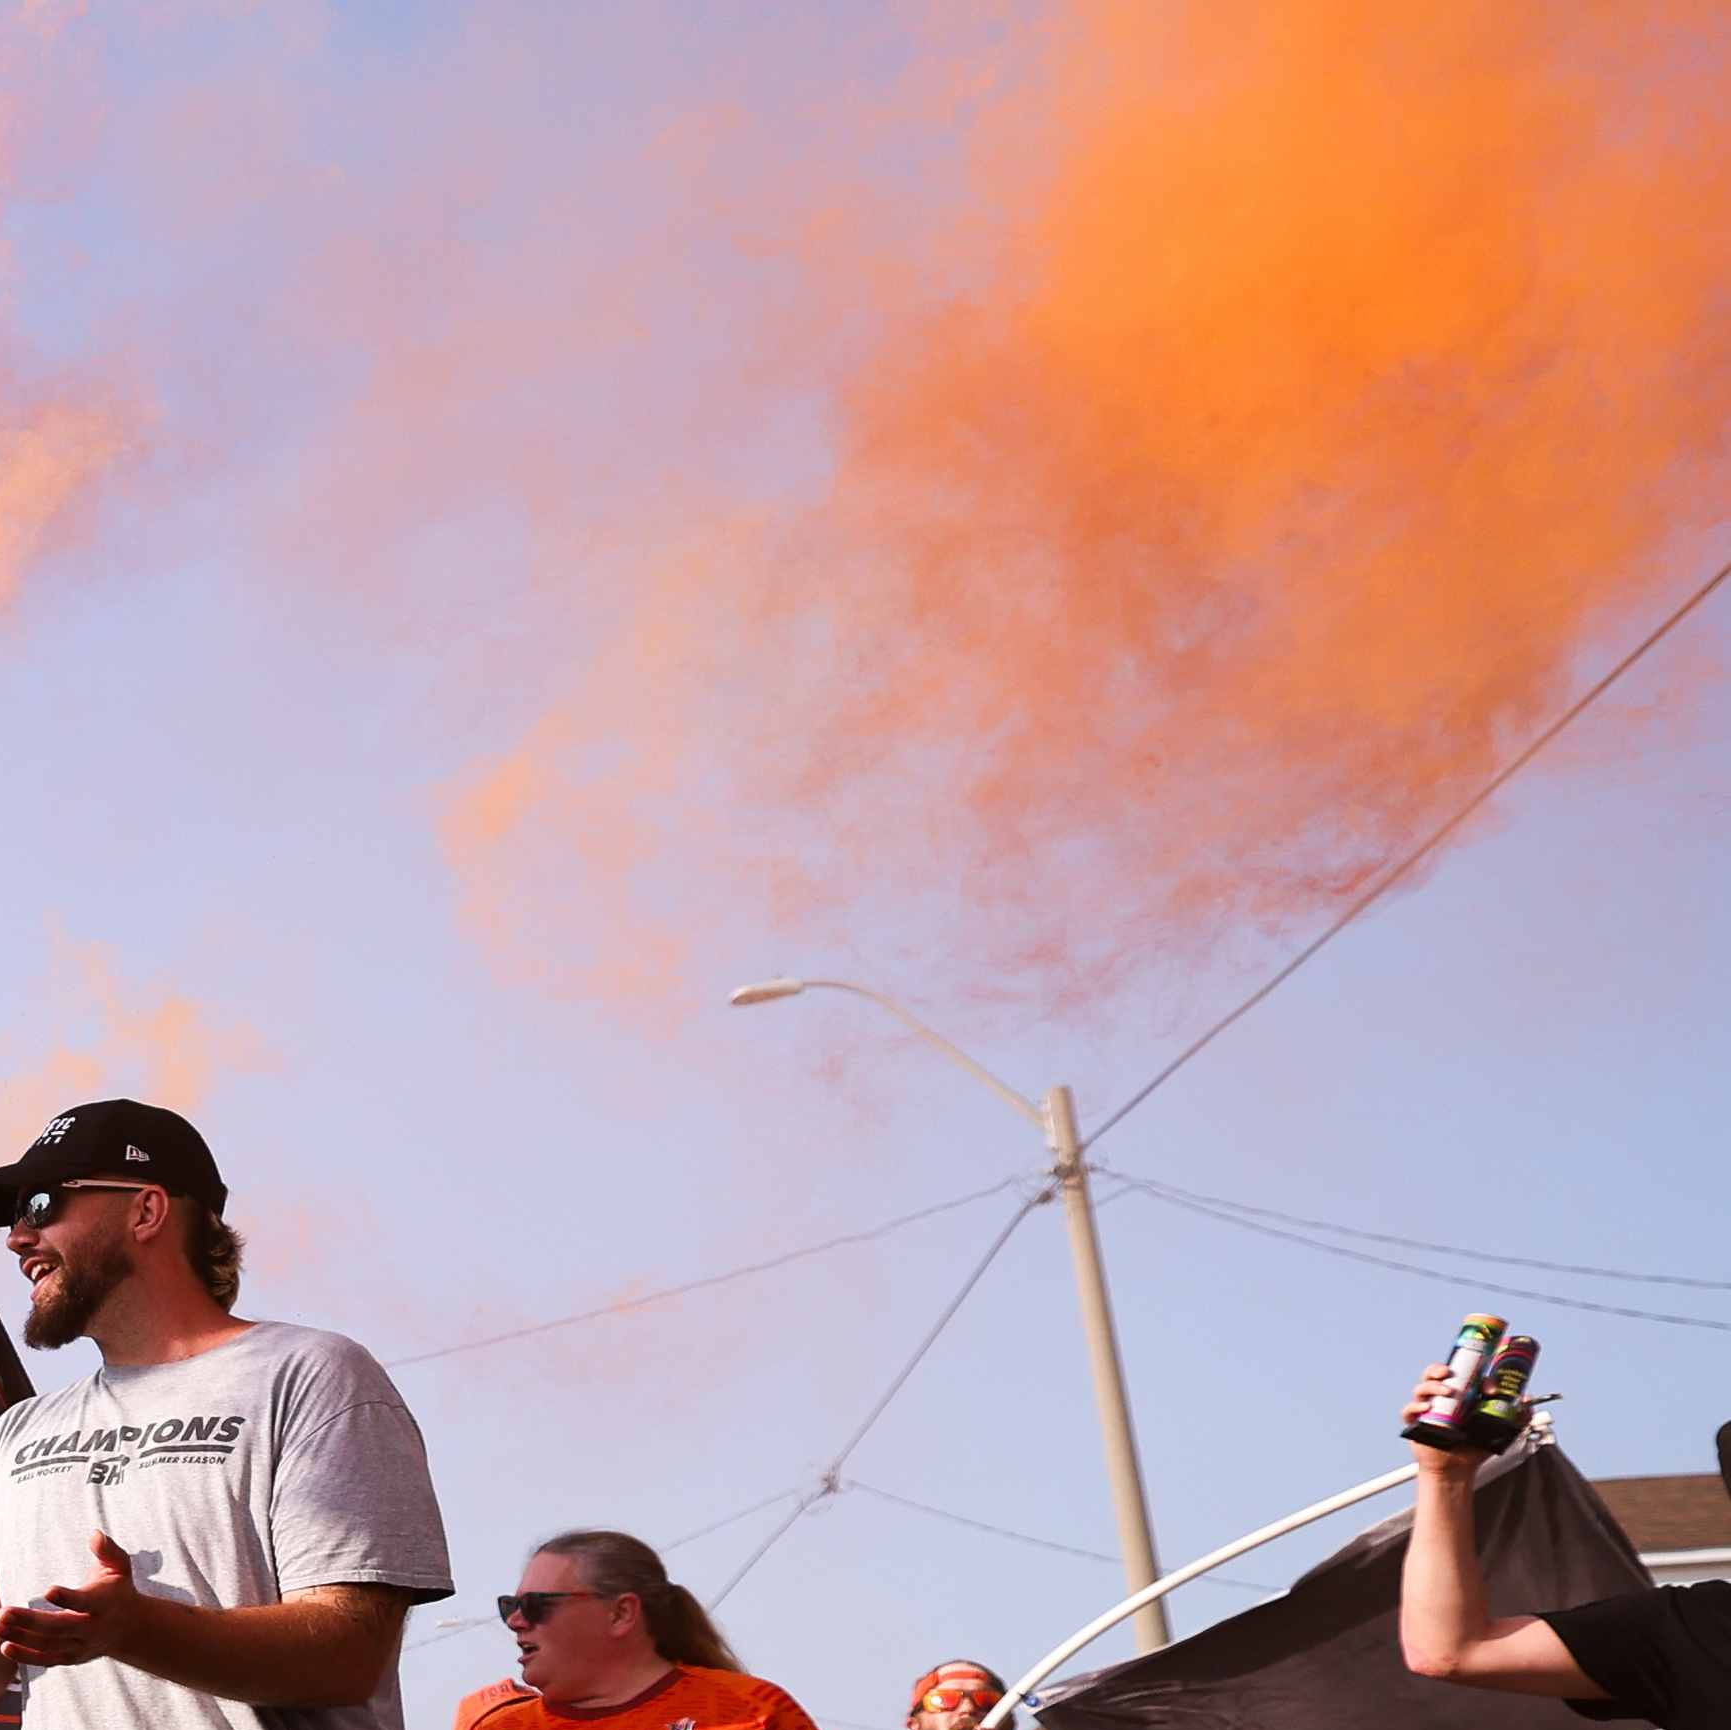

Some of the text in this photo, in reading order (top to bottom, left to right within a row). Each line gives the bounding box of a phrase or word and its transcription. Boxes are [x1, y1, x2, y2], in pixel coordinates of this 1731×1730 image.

[14, 1415, 246, 1465] CHAMPIONS
[139, 1455, 227, 1470] SUMMER SEASON
